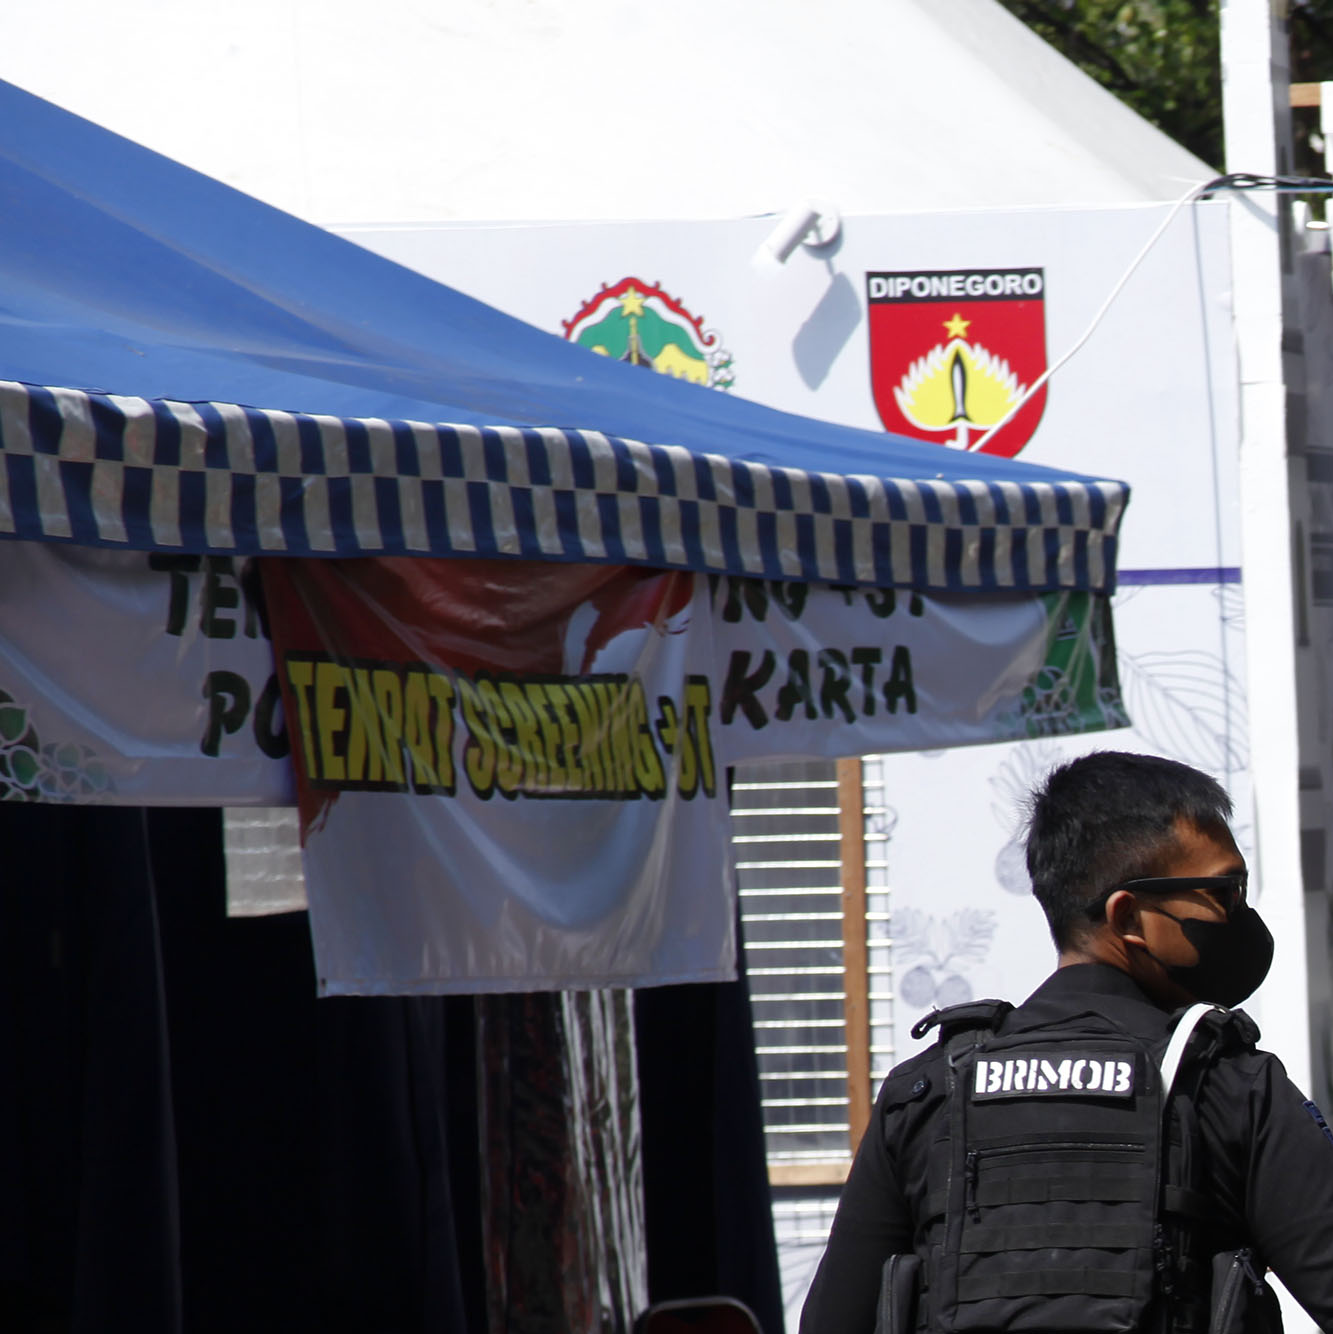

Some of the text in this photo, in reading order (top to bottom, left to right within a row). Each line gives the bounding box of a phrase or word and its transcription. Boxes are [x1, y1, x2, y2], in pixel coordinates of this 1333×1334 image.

[869, 273, 1043, 299] DIPONEGORO
[457, 668, 667, 800] SCREENING
[975, 1058, 1132, 1094] BRIMOB
